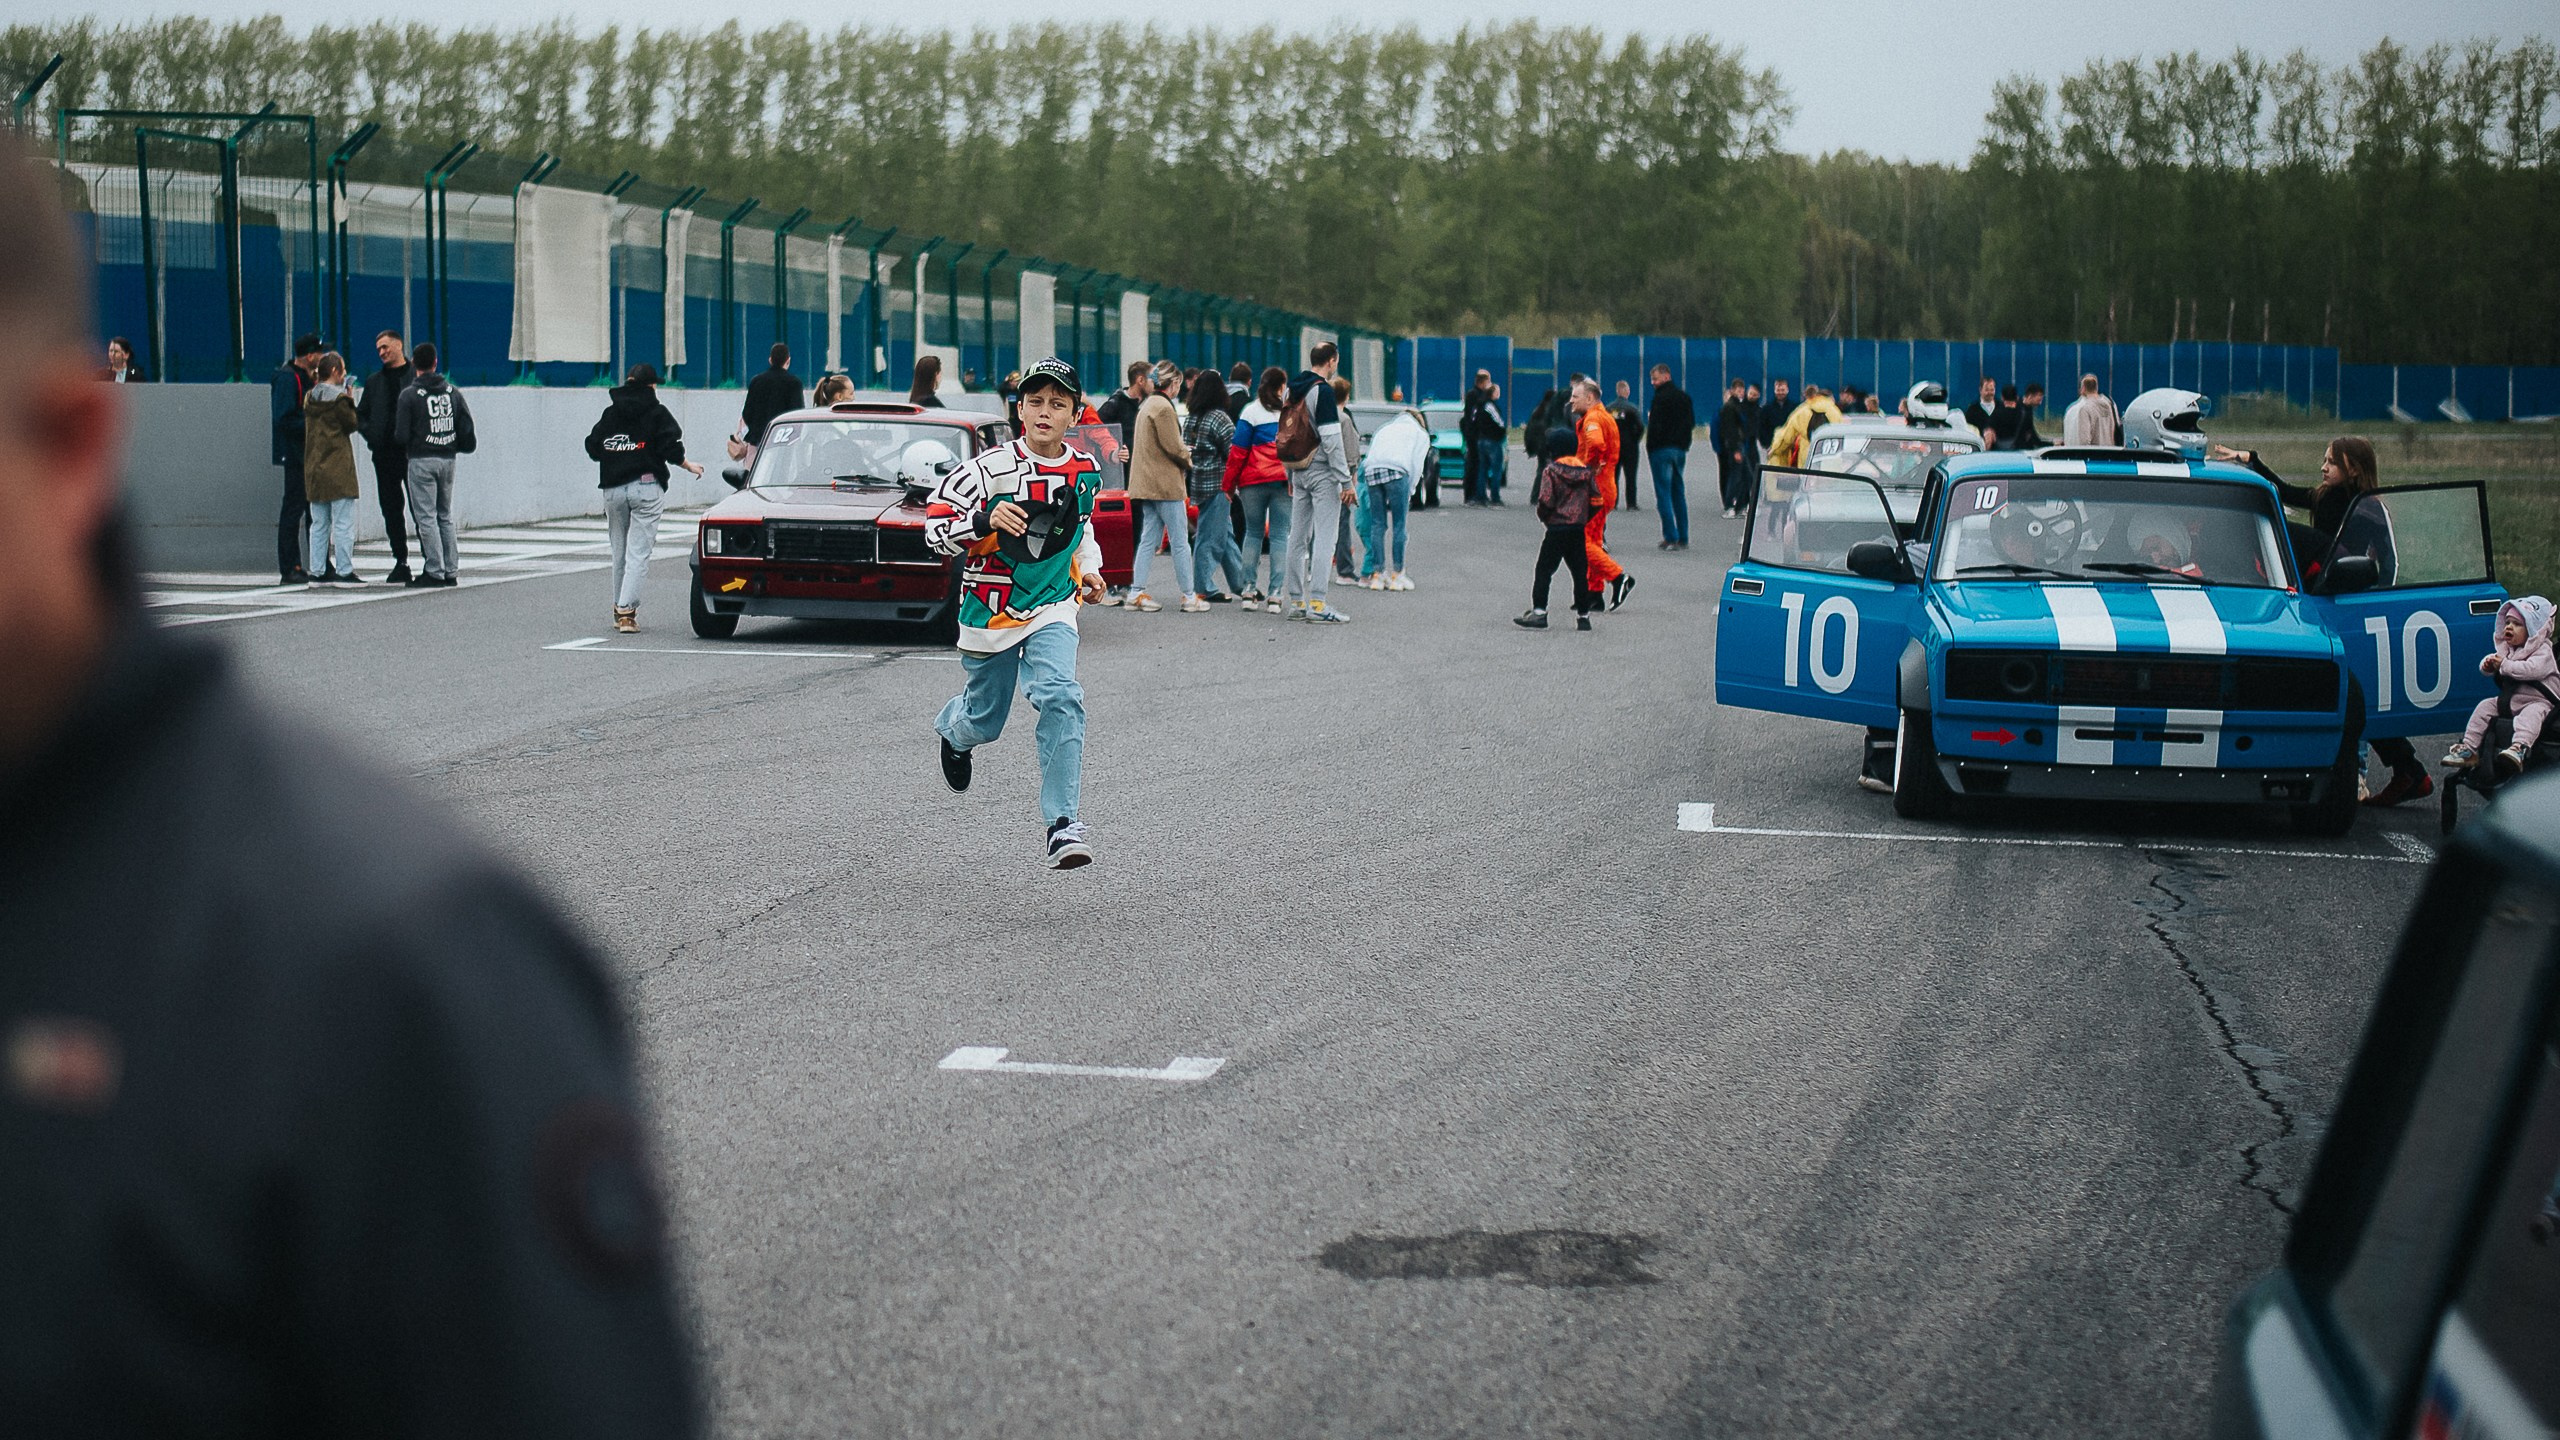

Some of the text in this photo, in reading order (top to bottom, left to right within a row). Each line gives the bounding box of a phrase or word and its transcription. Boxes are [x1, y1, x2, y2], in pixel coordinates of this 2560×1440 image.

[1974, 485, 1999, 510] 10
[1781, 591, 1859, 694] 10
[2364, 610, 2452, 712] 10
